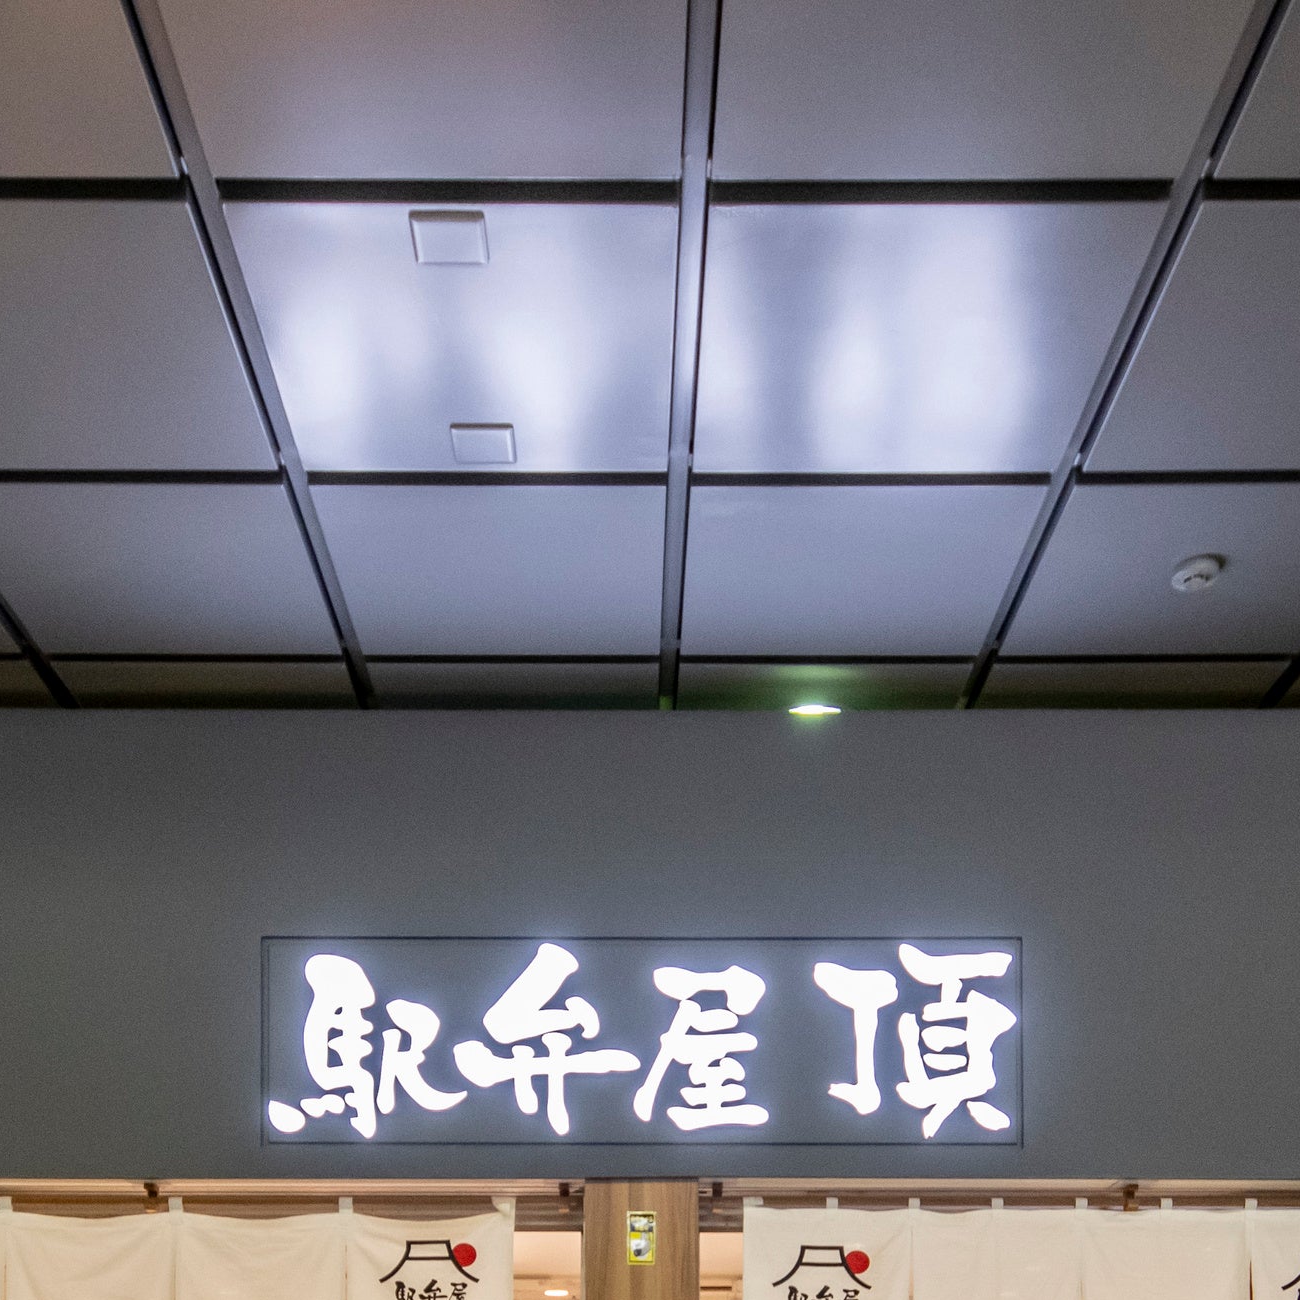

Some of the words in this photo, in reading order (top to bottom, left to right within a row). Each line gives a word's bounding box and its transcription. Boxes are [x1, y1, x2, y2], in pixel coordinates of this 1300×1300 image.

[268, 943, 770, 1139] 駅弁屋
[814, 943, 1017, 1139] 頂
